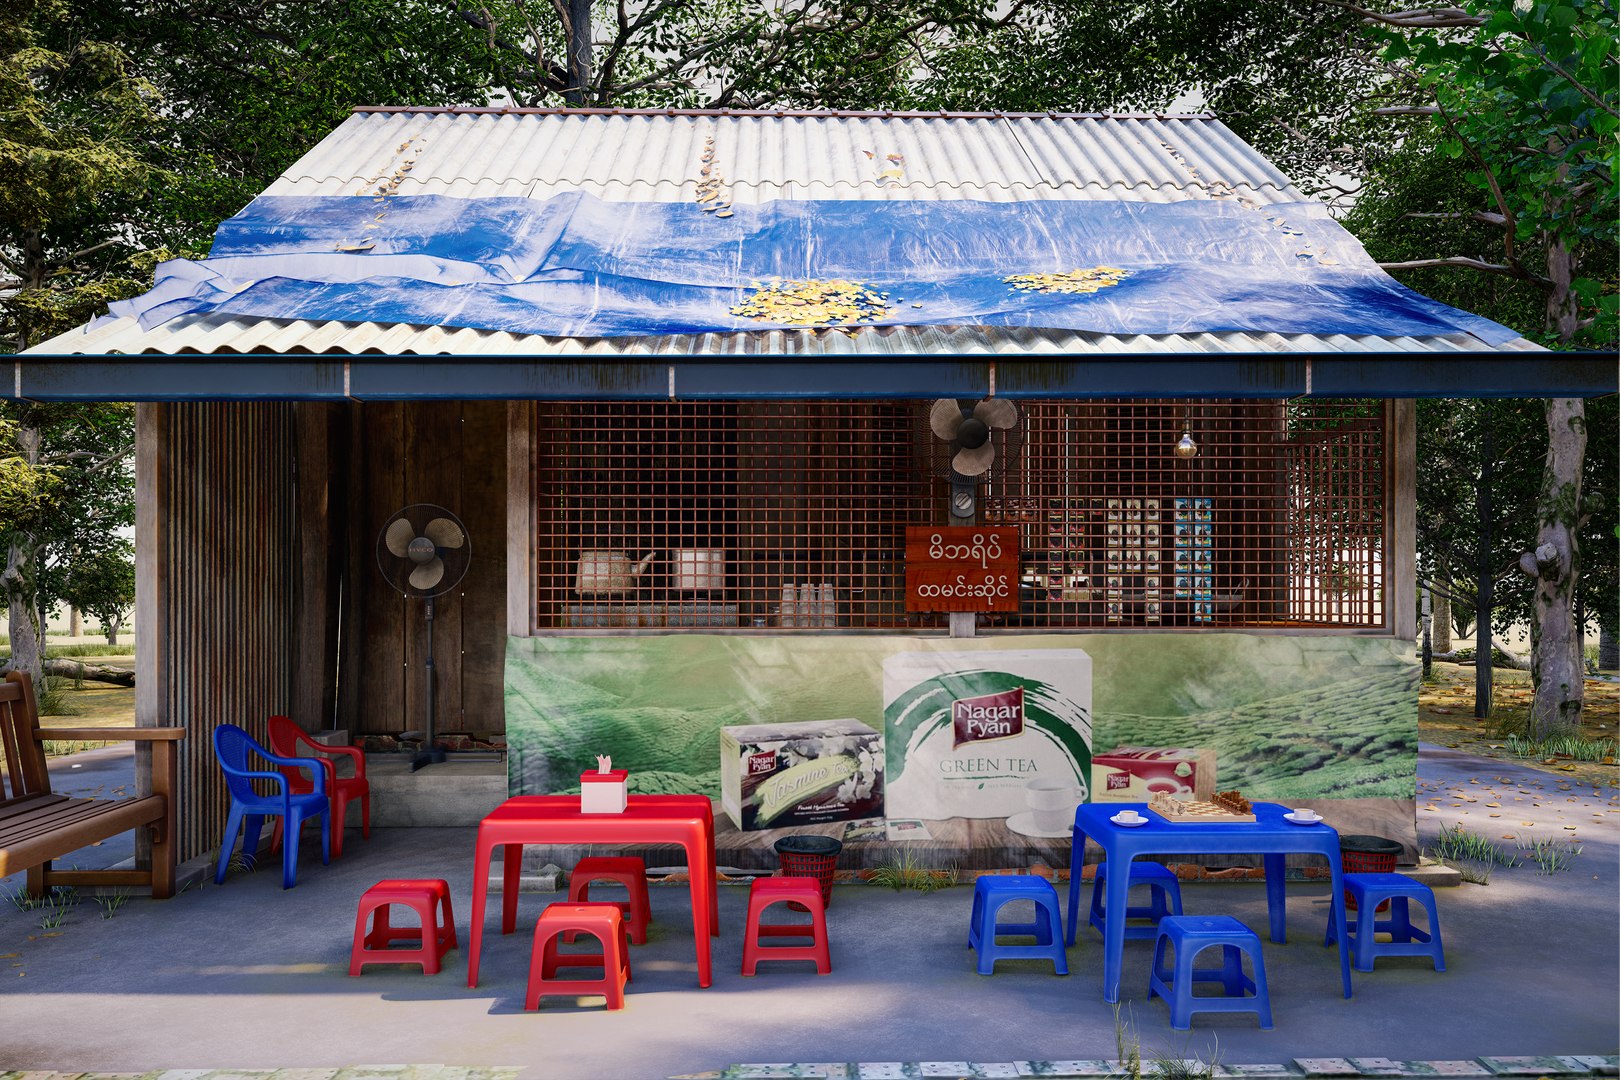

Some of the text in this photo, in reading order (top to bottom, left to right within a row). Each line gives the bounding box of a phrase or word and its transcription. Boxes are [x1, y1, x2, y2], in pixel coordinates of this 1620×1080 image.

[929, 533, 1002, 569] မိဘရိပ်
[918, 575, 1009, 605] ထမင်းဆိုင်
[957, 704, 1020, 724] Nagar
[967, 720, 1011, 737] Pyan
[749, 756, 774, 765] Nagar
[752, 763, 771, 772] Pyan
[939, 758, 1038, 772] GREEN TEA
[764, 762, 849, 807] Jasmine Tea
[1108, 775, 1129, 783] Nagar
